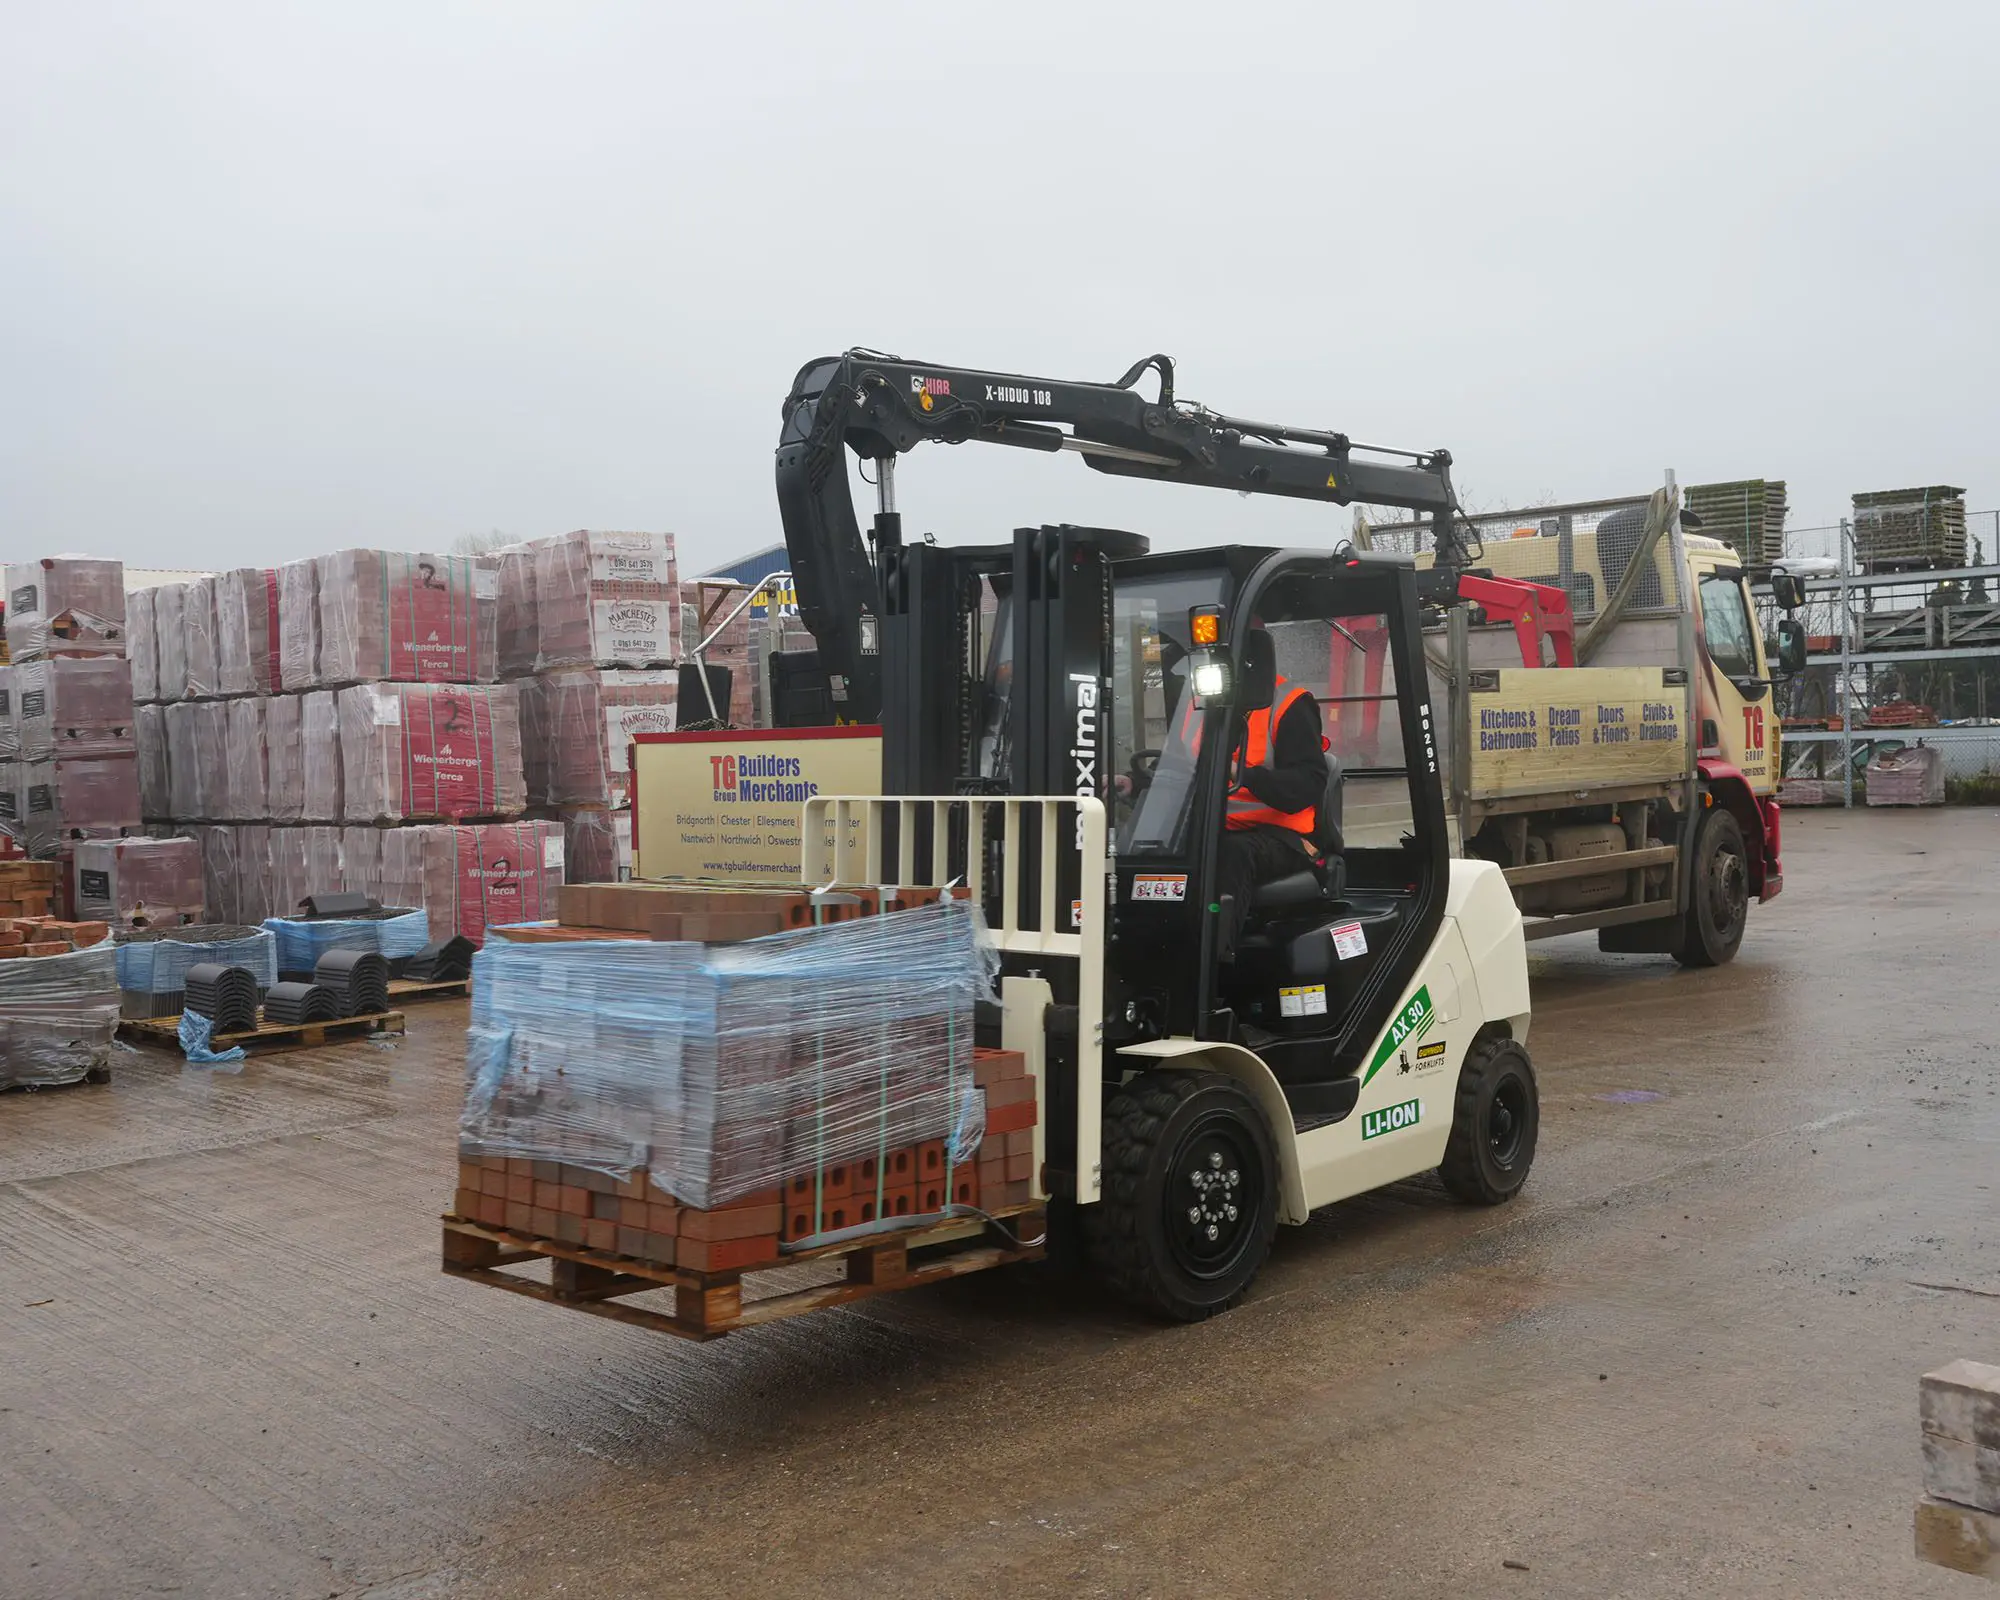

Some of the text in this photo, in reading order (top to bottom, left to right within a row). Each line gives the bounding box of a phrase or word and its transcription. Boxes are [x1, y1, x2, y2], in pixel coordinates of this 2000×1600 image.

[925, 377, 950, 395] HIAB
[986, 384, 1051, 406] X-HIDUO 108
[608, 608, 657, 628] MANCHESTER
[422, 659, 449, 669] Terca
[1480, 708, 1537, 730] Kitchens &
[1548, 706, 1581, 726] Dream
[1597, 704, 1625, 723] Doors
[1642, 703, 1675, 721] Civils &
[619, 712, 671, 737] MANCHESTER
[1593, 725, 1630, 744] & Floors
[1639, 723, 1678, 742] Drainage
[1742, 705, 1764, 750] TG
[1480, 730, 1537, 751] Bathrooms
[1549, 727, 1580, 747] Patios
[710, 754, 737, 790] TG
[738, 754, 800, 777] Builders
[436, 771, 463, 782] Terca
[713, 790, 737, 803] Group
[739, 779, 818, 802] Merchants
[676, 814, 795, 829] Bridgnorth Chester Ellesmere
[680, 832, 715, 845] Nantwich
[720, 833, 762, 846] Northwich
[767, 834, 804, 847] Oswestr
[491, 858, 518, 889] 2
[703, 860, 832, 876] www.tgbuildersmerchantk
[488, 885, 516, 896] Terca
[1391, 999, 1425, 1046] AX 30
[1414, 1056, 1446, 1073] FORKLIFTS
[1365, 1102, 1417, 1137] LI-ION
